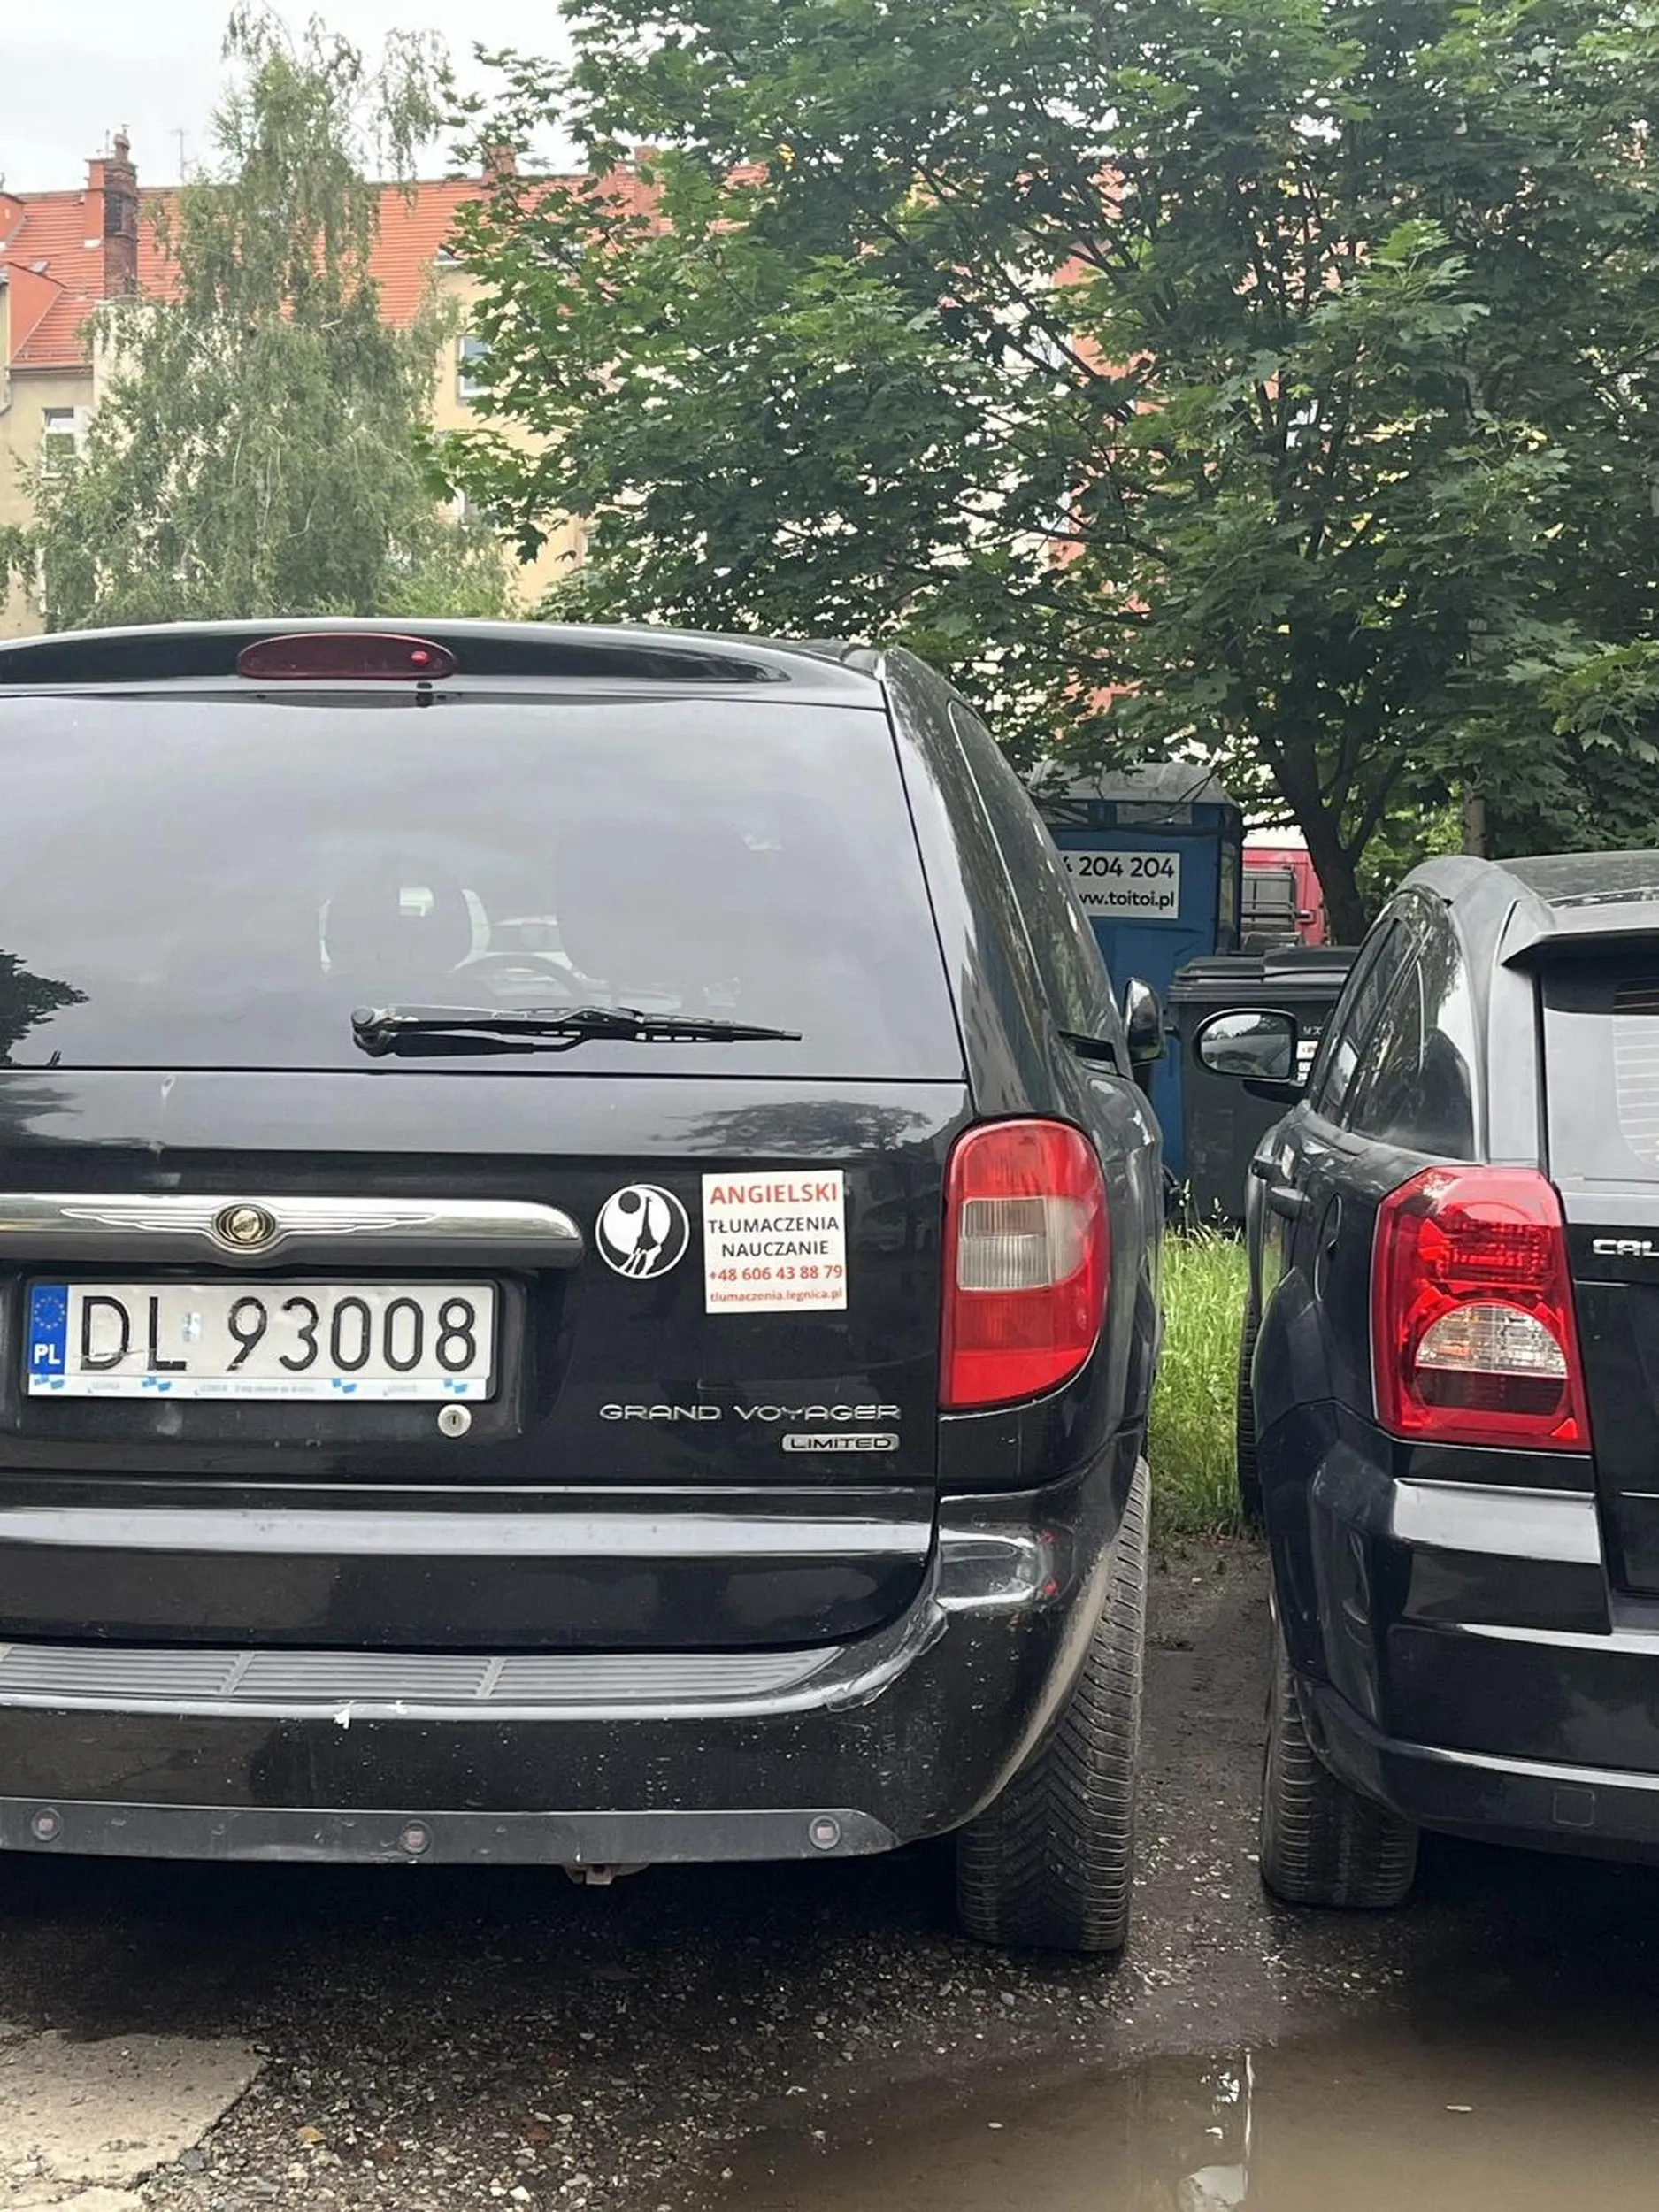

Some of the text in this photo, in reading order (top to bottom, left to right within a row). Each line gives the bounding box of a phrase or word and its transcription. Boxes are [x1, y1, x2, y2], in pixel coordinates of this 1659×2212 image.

[1079, 856, 1124, 877] 204
[1130, 857, 1175, 879] 204
[710, 1182, 838, 1205] ANGIELSKI
[707, 1217, 840, 1234] TŁUMACZENIA
[721, 1240, 829, 1258] NAUCZANIE
[710, 1264, 844, 1282] +48 606 43 88 79
[710, 1287, 843, 1303] tlumaczenia.legnica.pl
[81, 1295, 477, 1372] DL 93008
[34, 1343, 61, 1365] PL
[600, 1403, 902, 1421] GRAND VOYAGER
[790, 1438, 892, 1449] LIMITED
